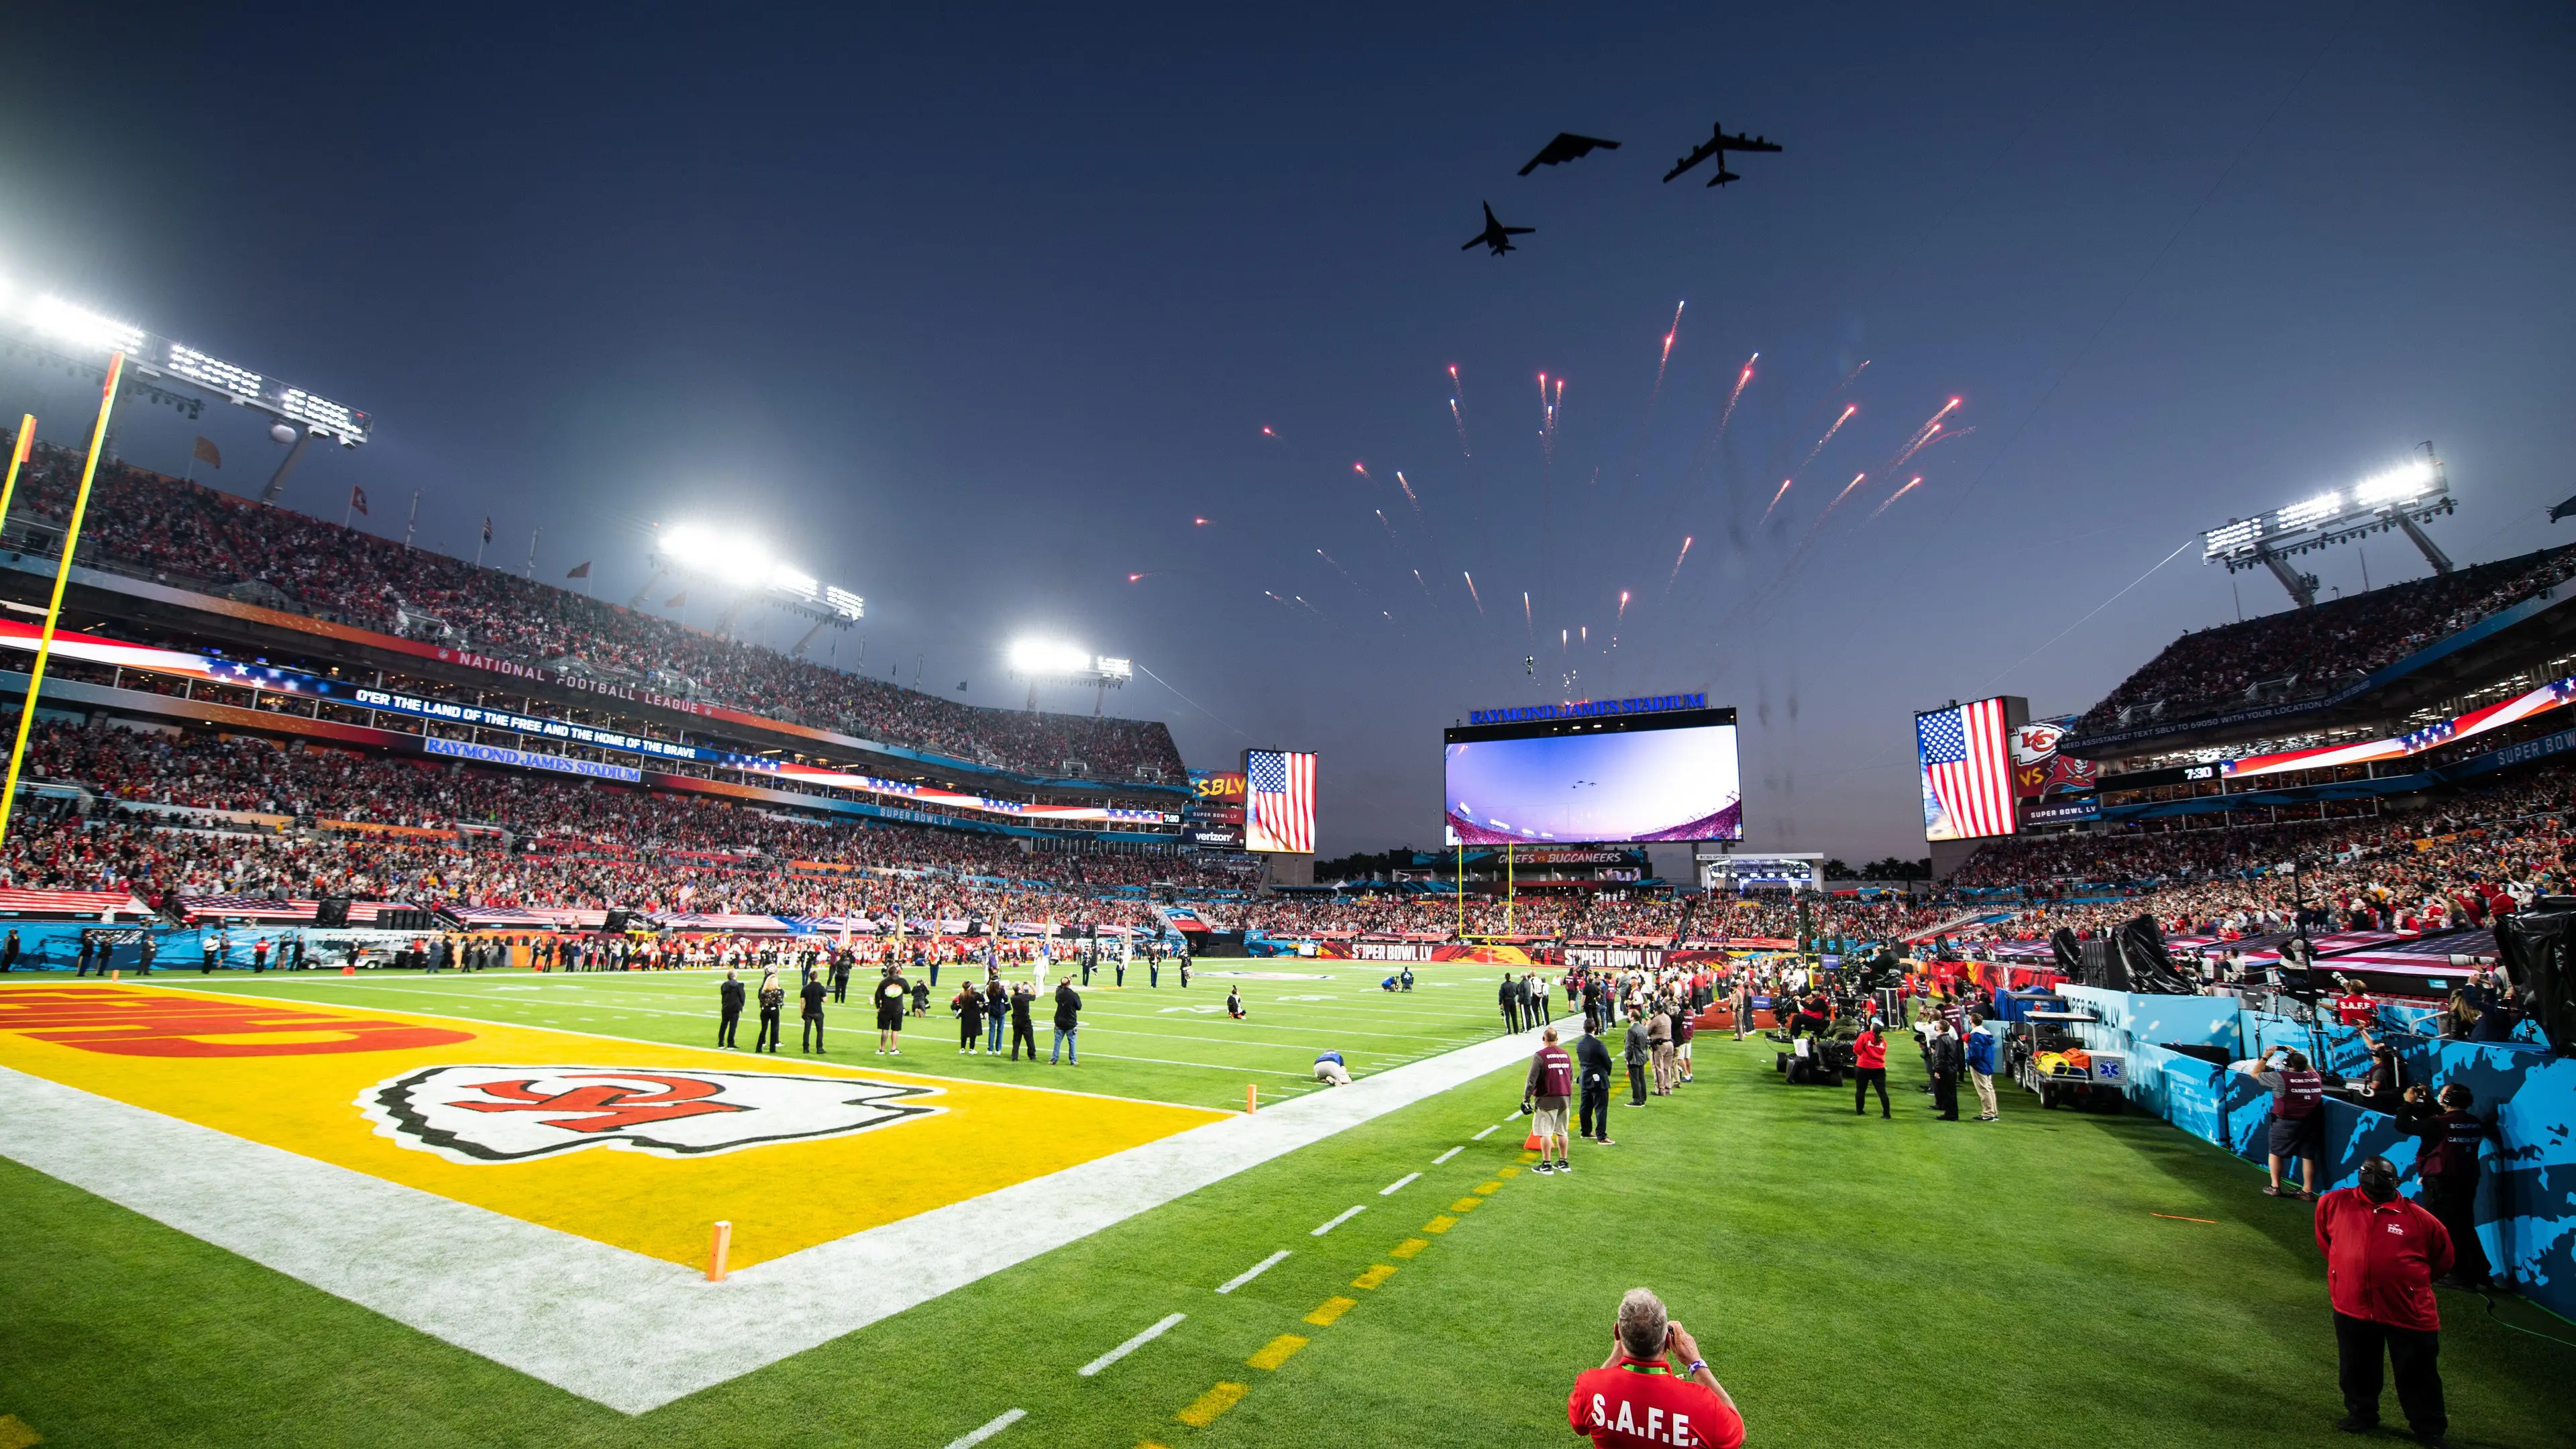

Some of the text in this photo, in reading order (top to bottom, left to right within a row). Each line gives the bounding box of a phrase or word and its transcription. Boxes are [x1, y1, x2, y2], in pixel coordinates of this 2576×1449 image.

[460, 653, 545, 682] NATIONAL
[556, 675, 635, 700] FOOTBALL
[645, 693, 698, 714] LEAGUE
[1470, 693, 1705, 725] RAYMOND JAMES STADIUM
[356, 690, 696, 759] O'ER THE LAND OF THE FREE AND THE HOME OF THE BRAVE
[2061, 742, 2080, 750] NEED
[2082, 733, 2131, 746] ASSISTANCE?
[2133, 729, 2153, 738] TEXT
[2155, 726, 2176, 735] SBLV
[2190, 718, 2218, 729] 69050
[2220, 714, 2244, 724] WITH
[2246, 710, 2272, 719] YOUR
[2274, 701, 2322, 715] LOCATION
[427, 739, 641, 782] RAYMOND JAMES STADIUM
[2497, 742, 2540, 765] SUPER
[2019, 767, 2045, 787] VS
[2184, 766, 2212, 780] 7:30
[880, 808, 952, 826] SUPER BOWL LV
[1164, 814, 1179, 823] 7:30
[2031, 810, 2057, 818] SUPER
[2059, 807, 2082, 816] BOWL
[1195, 832, 1230, 842] verizon
[1498, 854, 1535, 864] CHIEFS
[1547, 853, 1621, 863] BUCCANEERS
[1387, 945, 1418, 961] BOWL
[1419, 945, 1432, 961] LV
[1607, 951, 1644, 967] BOWL
[1646, 951, 1662, 968] LV
[1591, 1393, 1699, 1446] S.A.F.E.
